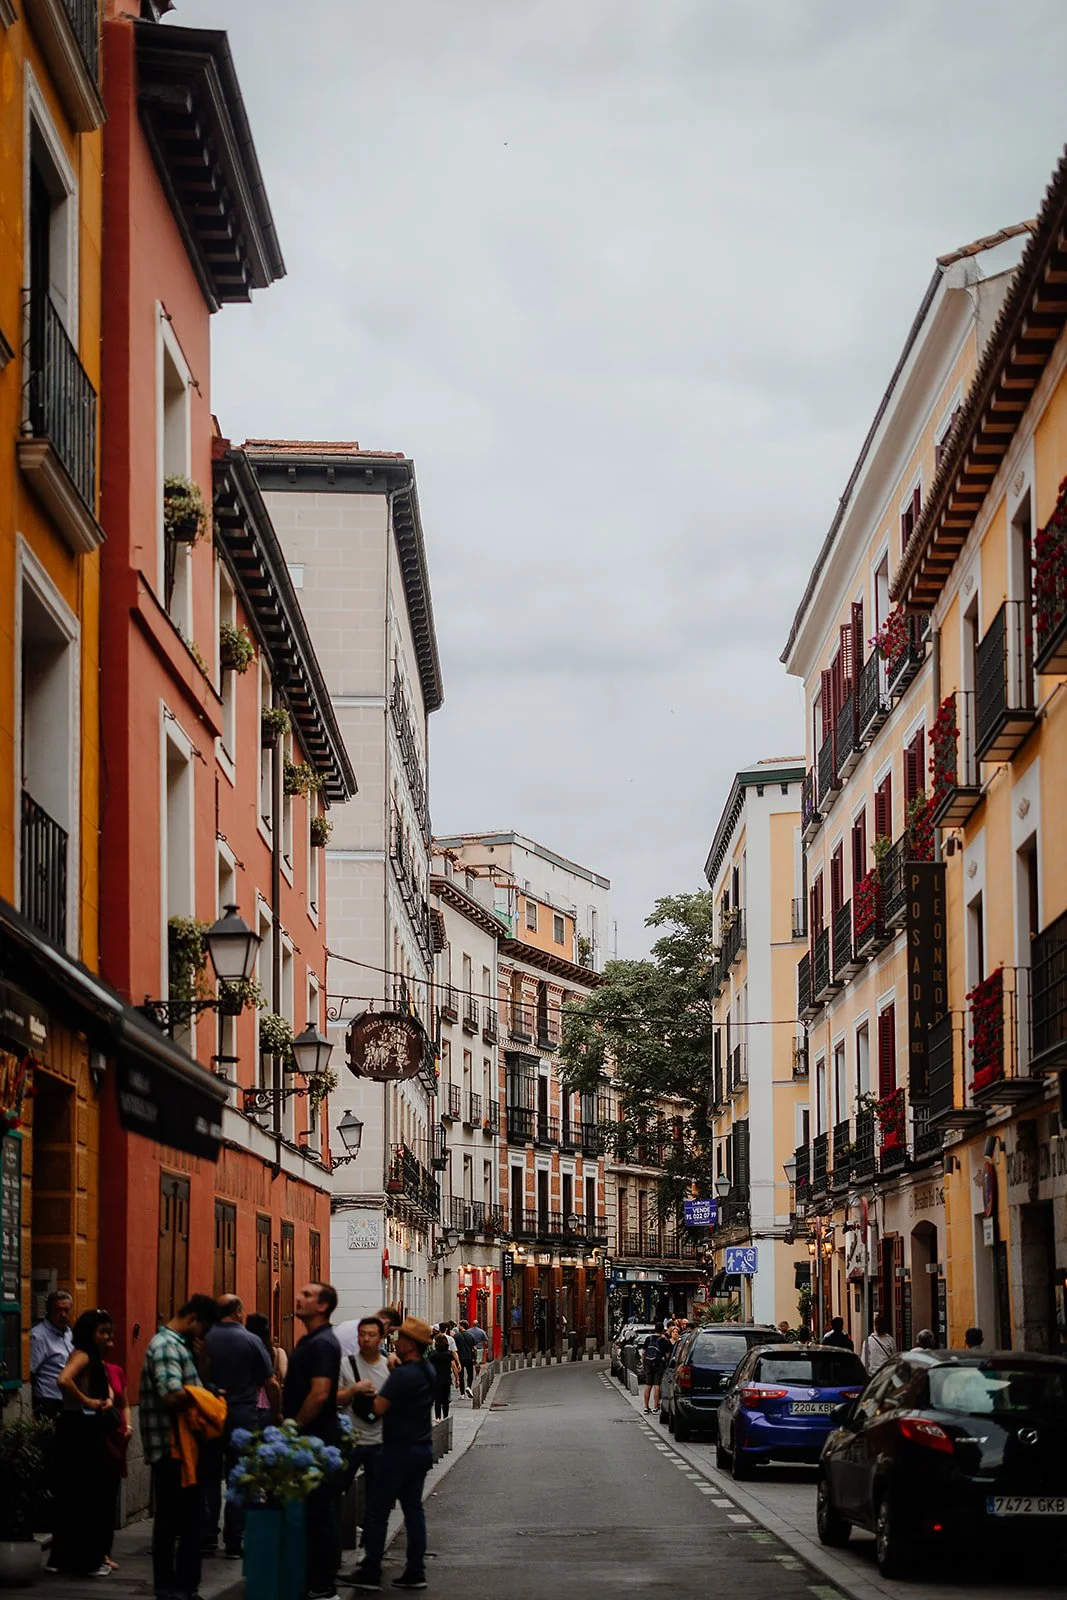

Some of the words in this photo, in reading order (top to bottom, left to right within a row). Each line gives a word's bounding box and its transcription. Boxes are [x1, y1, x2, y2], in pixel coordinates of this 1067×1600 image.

[912, 874, 921, 1028] POSADA
[362, 1019, 383, 1034] POSADA
[402, 1021, 417, 1039] VILLA
[505, 1254, 512, 1264] 17
[604, 1258, 611, 1268] 17
[794, 1403, 816, 1412] 2204
[996, 1498, 1032, 1512] 7472
[1037, 1498, 1065, 1512] GKB
